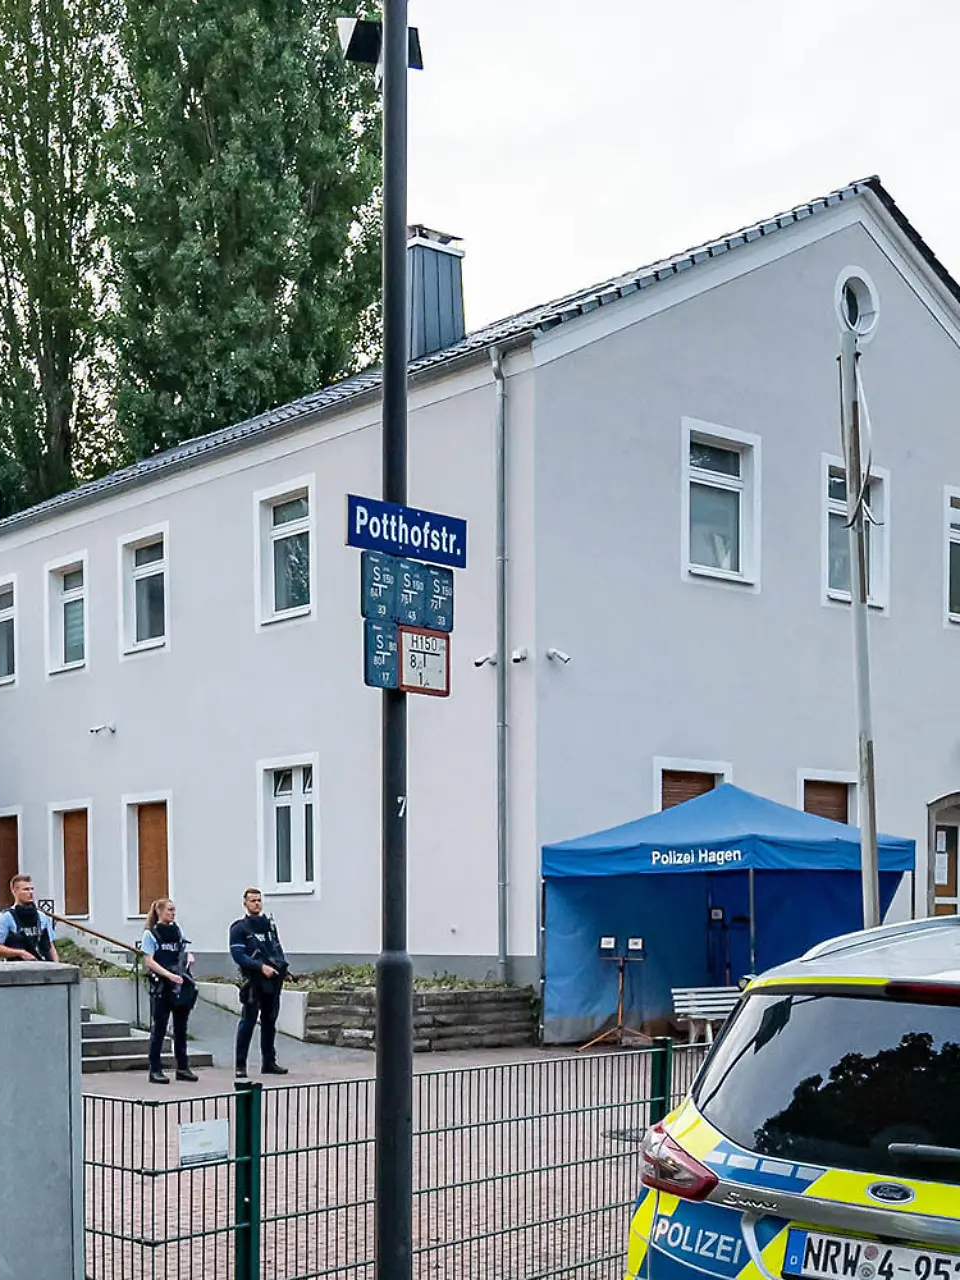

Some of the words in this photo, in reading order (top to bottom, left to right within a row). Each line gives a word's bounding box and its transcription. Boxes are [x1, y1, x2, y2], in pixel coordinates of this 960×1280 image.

[355, 505, 461, 556] Potthofstr.
[373, 566, 381, 582] S
[403, 573, 411, 588] S
[433, 579, 440, 594] S
[376, 634, 384, 649] S
[652, 849, 695, 865] Polizei
[699, 849, 742, 865] Hagen
[654, 1217, 743, 1264] POLIZEI
[803, 1236, 861, 1277] NRW
